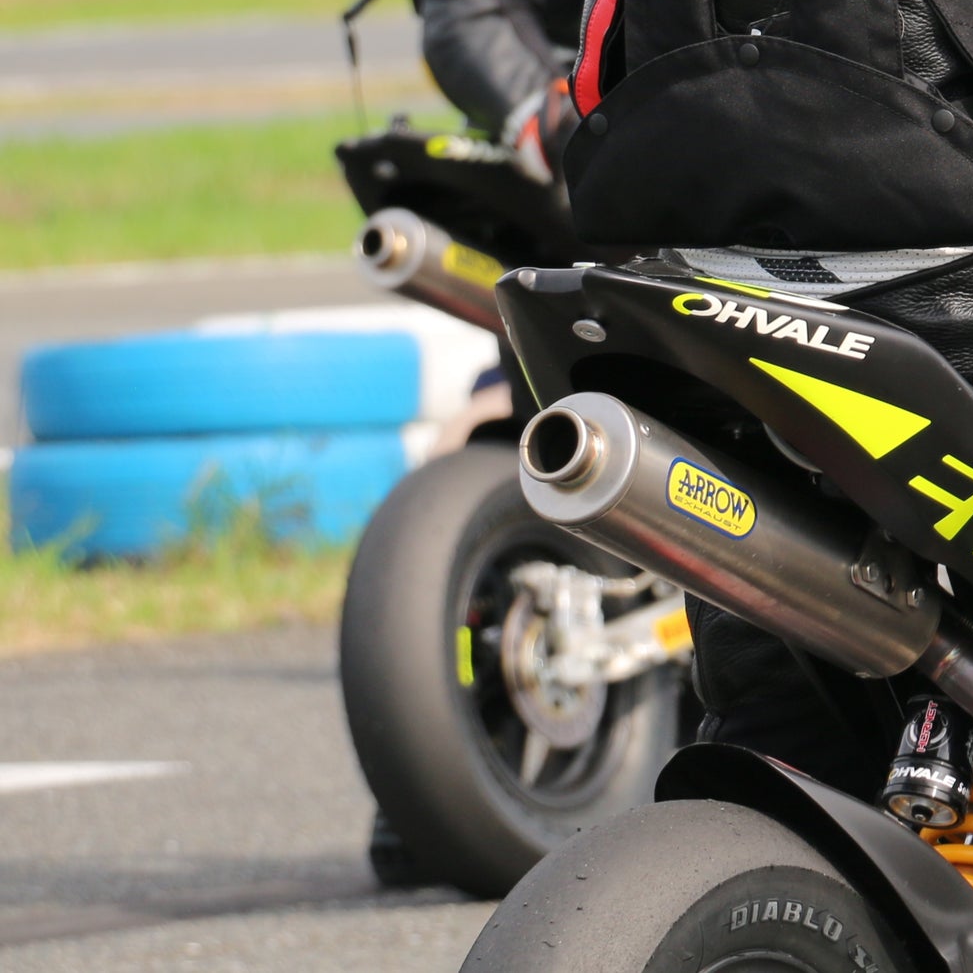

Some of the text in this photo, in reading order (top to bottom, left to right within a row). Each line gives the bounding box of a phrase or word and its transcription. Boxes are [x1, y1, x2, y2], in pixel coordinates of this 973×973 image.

[672, 292, 875, 360] OHVALE
[675, 495, 741, 530] EXHAUST
[678, 469, 749, 522] ARROW
[889, 766, 956, 788] OHVALE
[731, 900, 843, 942] DIABLO
